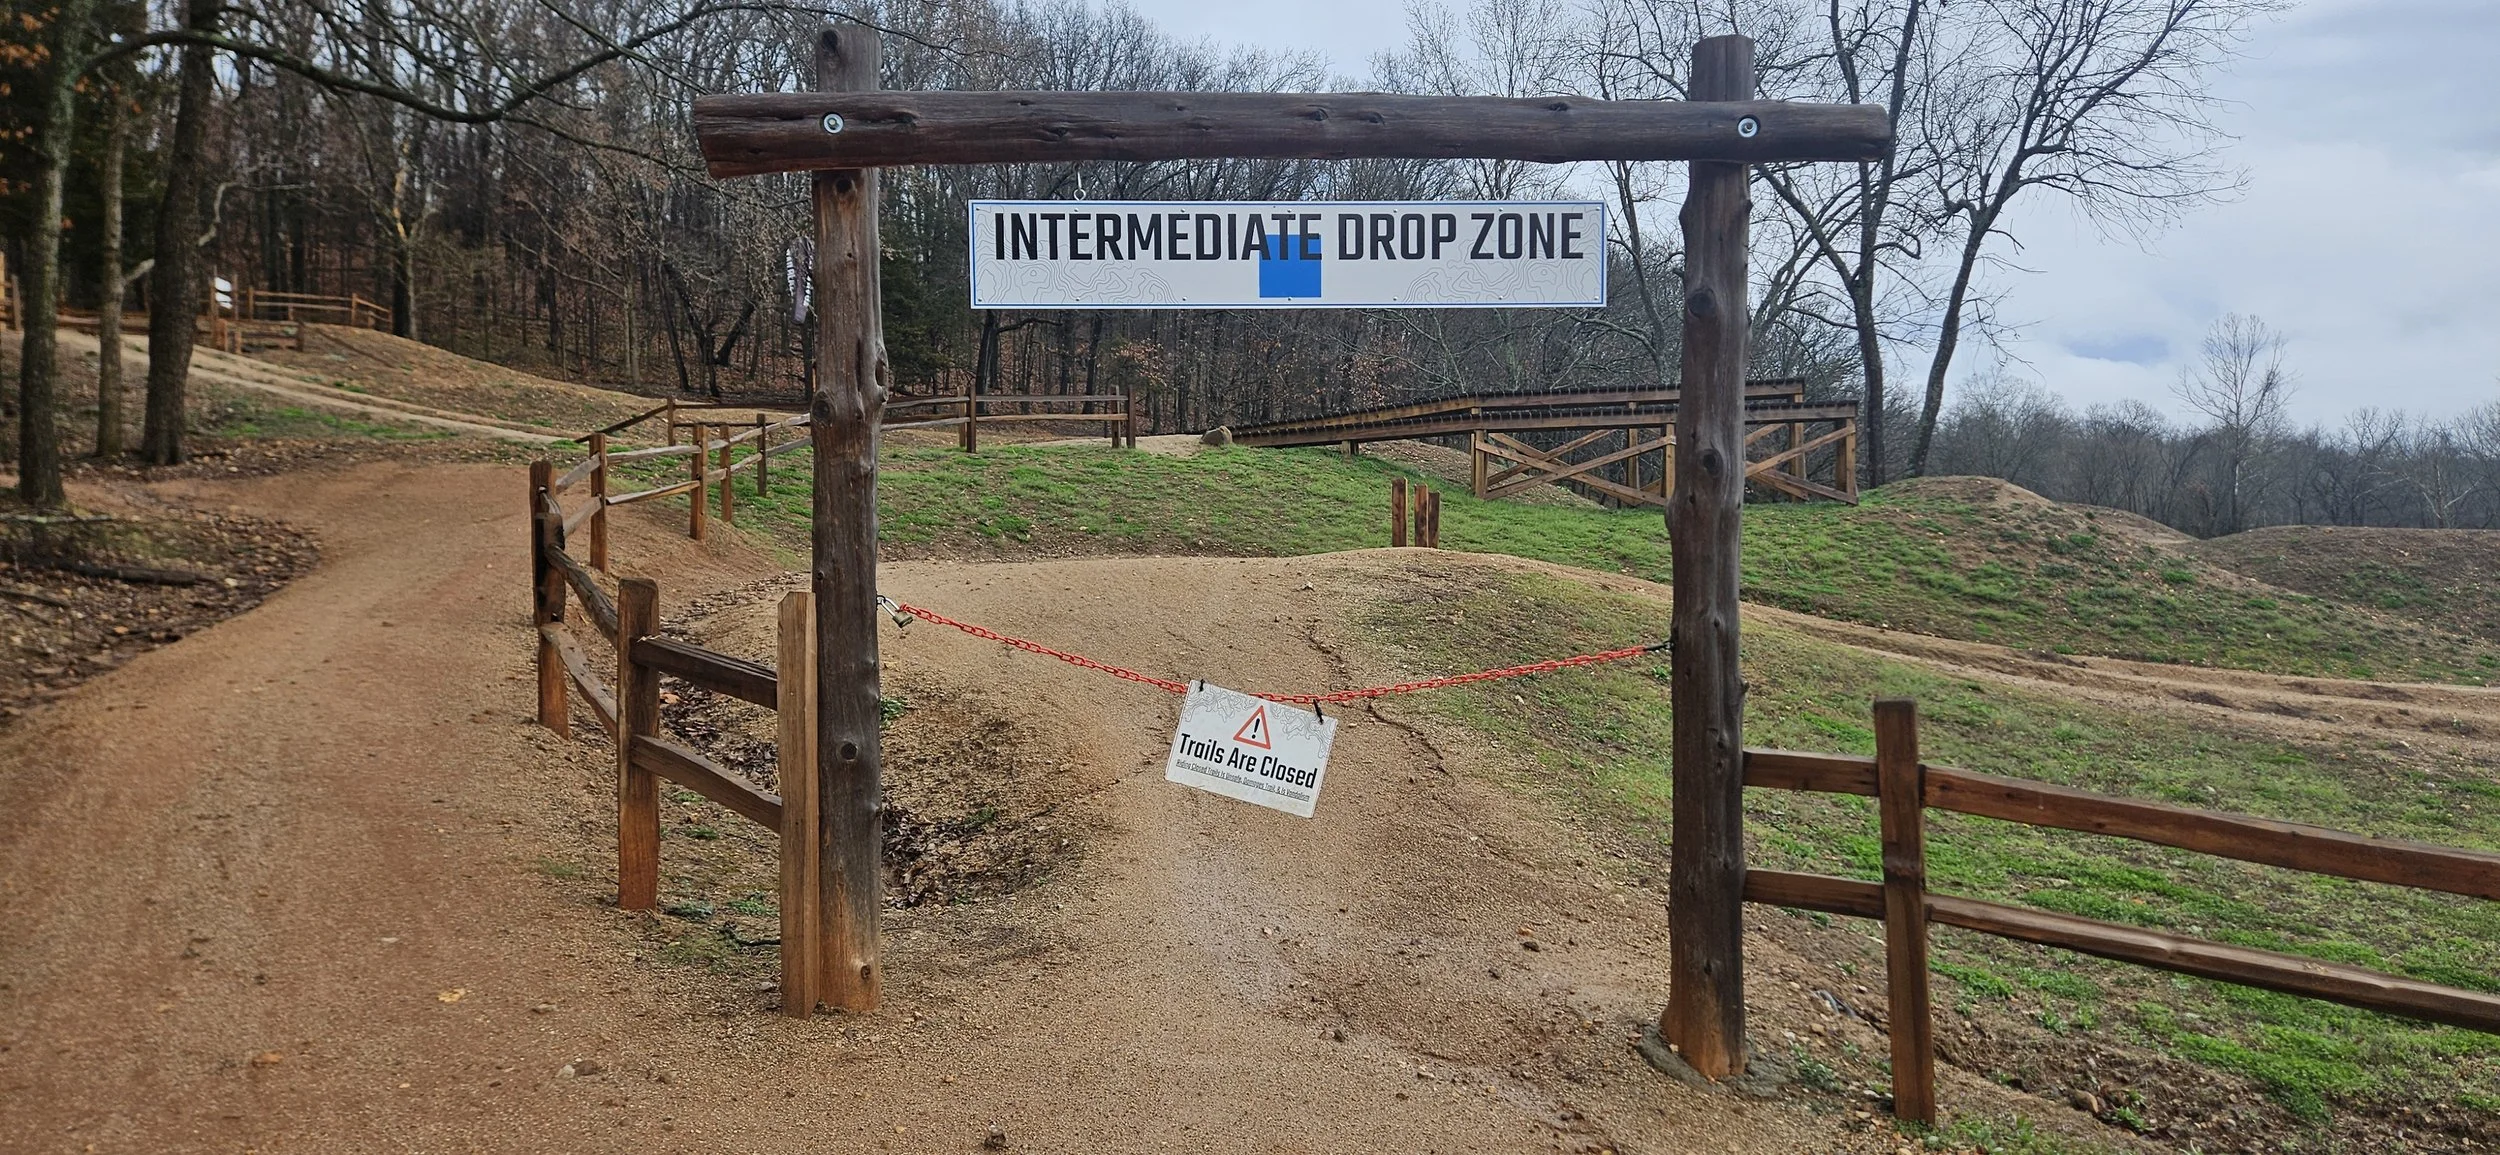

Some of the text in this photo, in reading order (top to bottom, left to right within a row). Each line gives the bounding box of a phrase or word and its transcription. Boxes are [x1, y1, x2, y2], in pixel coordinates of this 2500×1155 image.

[994, 212, 1584, 260] INTERMEDIATE DROP ZONE
[1179, 733, 1318, 789] Trails Are Closed
[1191, 763, 1207, 773] Closed
[1208, 767, 1220, 777] Trails
[1286, 787, 1310, 800] Vandalism
